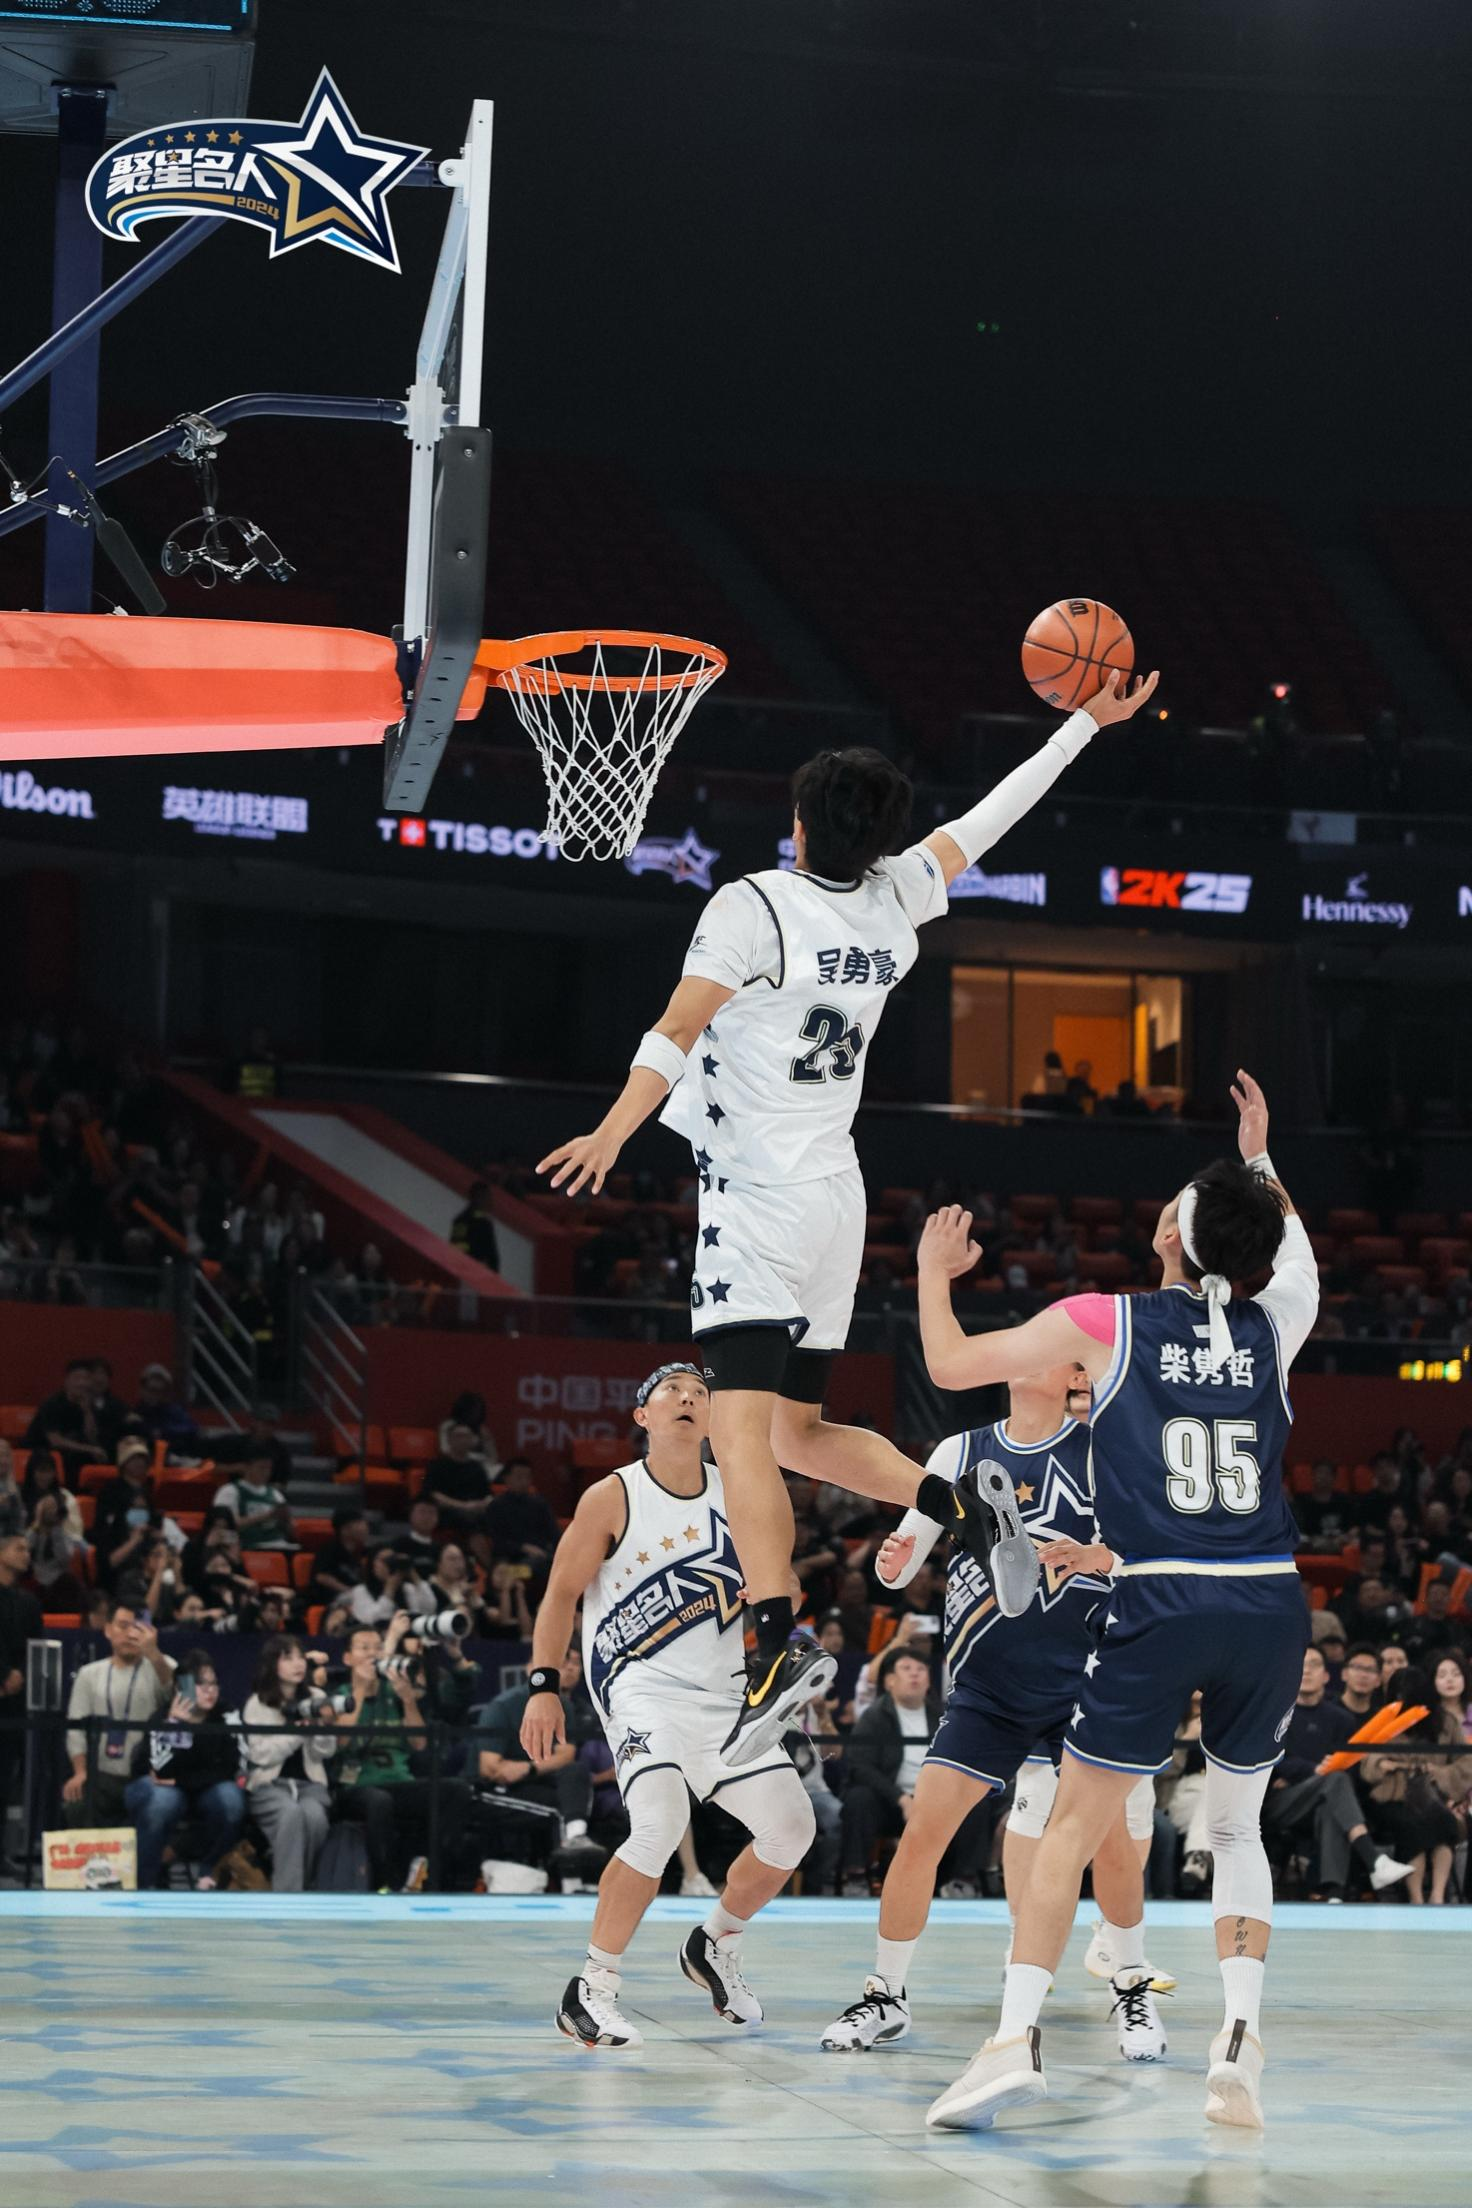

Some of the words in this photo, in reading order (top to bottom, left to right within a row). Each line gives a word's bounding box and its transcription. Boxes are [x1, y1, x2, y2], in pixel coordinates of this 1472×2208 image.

[0, 770, 95, 818] ilson
[428, 820, 561, 861] TISSOT
[1119, 867, 1252, 914] 2K25
[1302, 894, 1413, 929] Hennessy
[1162, 1416, 1261, 1515] 95
[594, 1569, 710, 1664] 聚星名人
[678, 1594, 717, 1623] 2024
